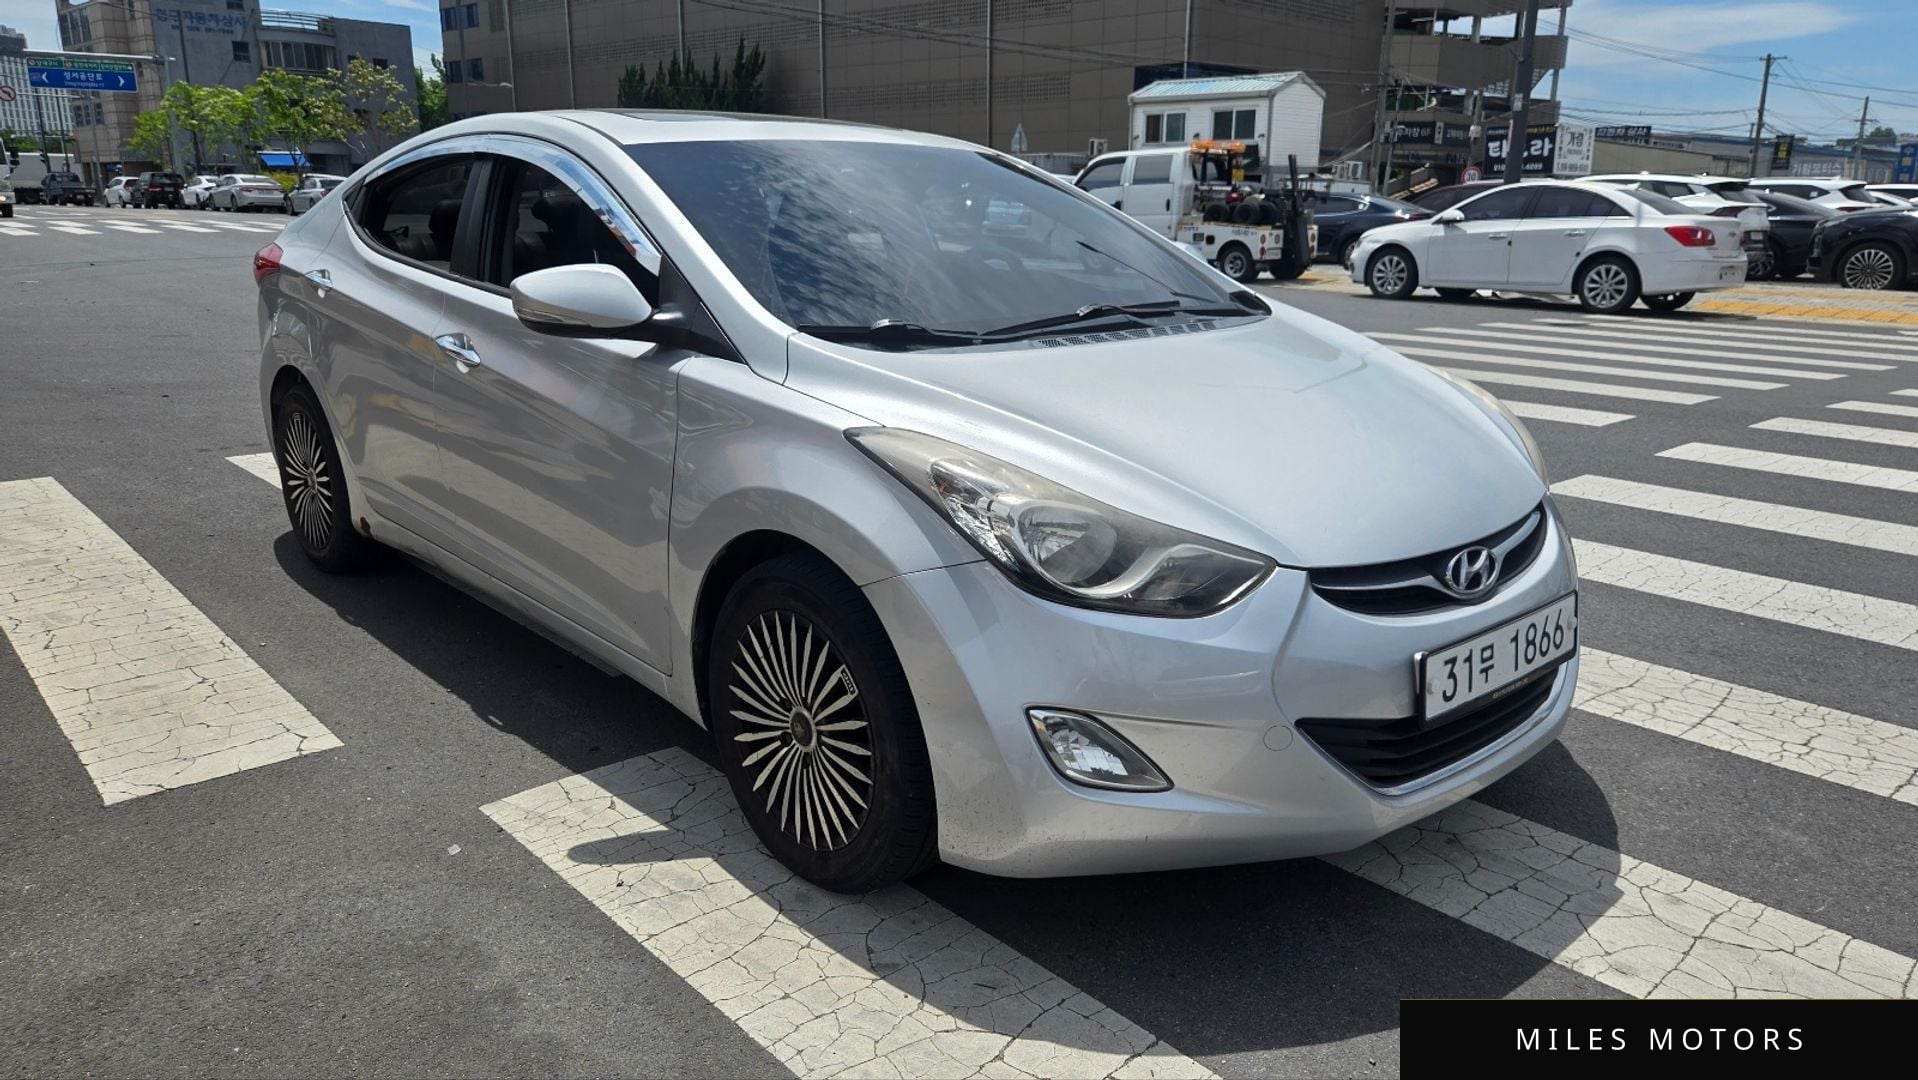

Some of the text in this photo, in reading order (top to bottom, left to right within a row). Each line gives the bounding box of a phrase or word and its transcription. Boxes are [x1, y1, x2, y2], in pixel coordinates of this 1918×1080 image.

[63, 71, 104, 81] 성서공단로
[1488, 136, 1554, 159] 타라
[1442, 608, 1564, 703] 31무 1866
